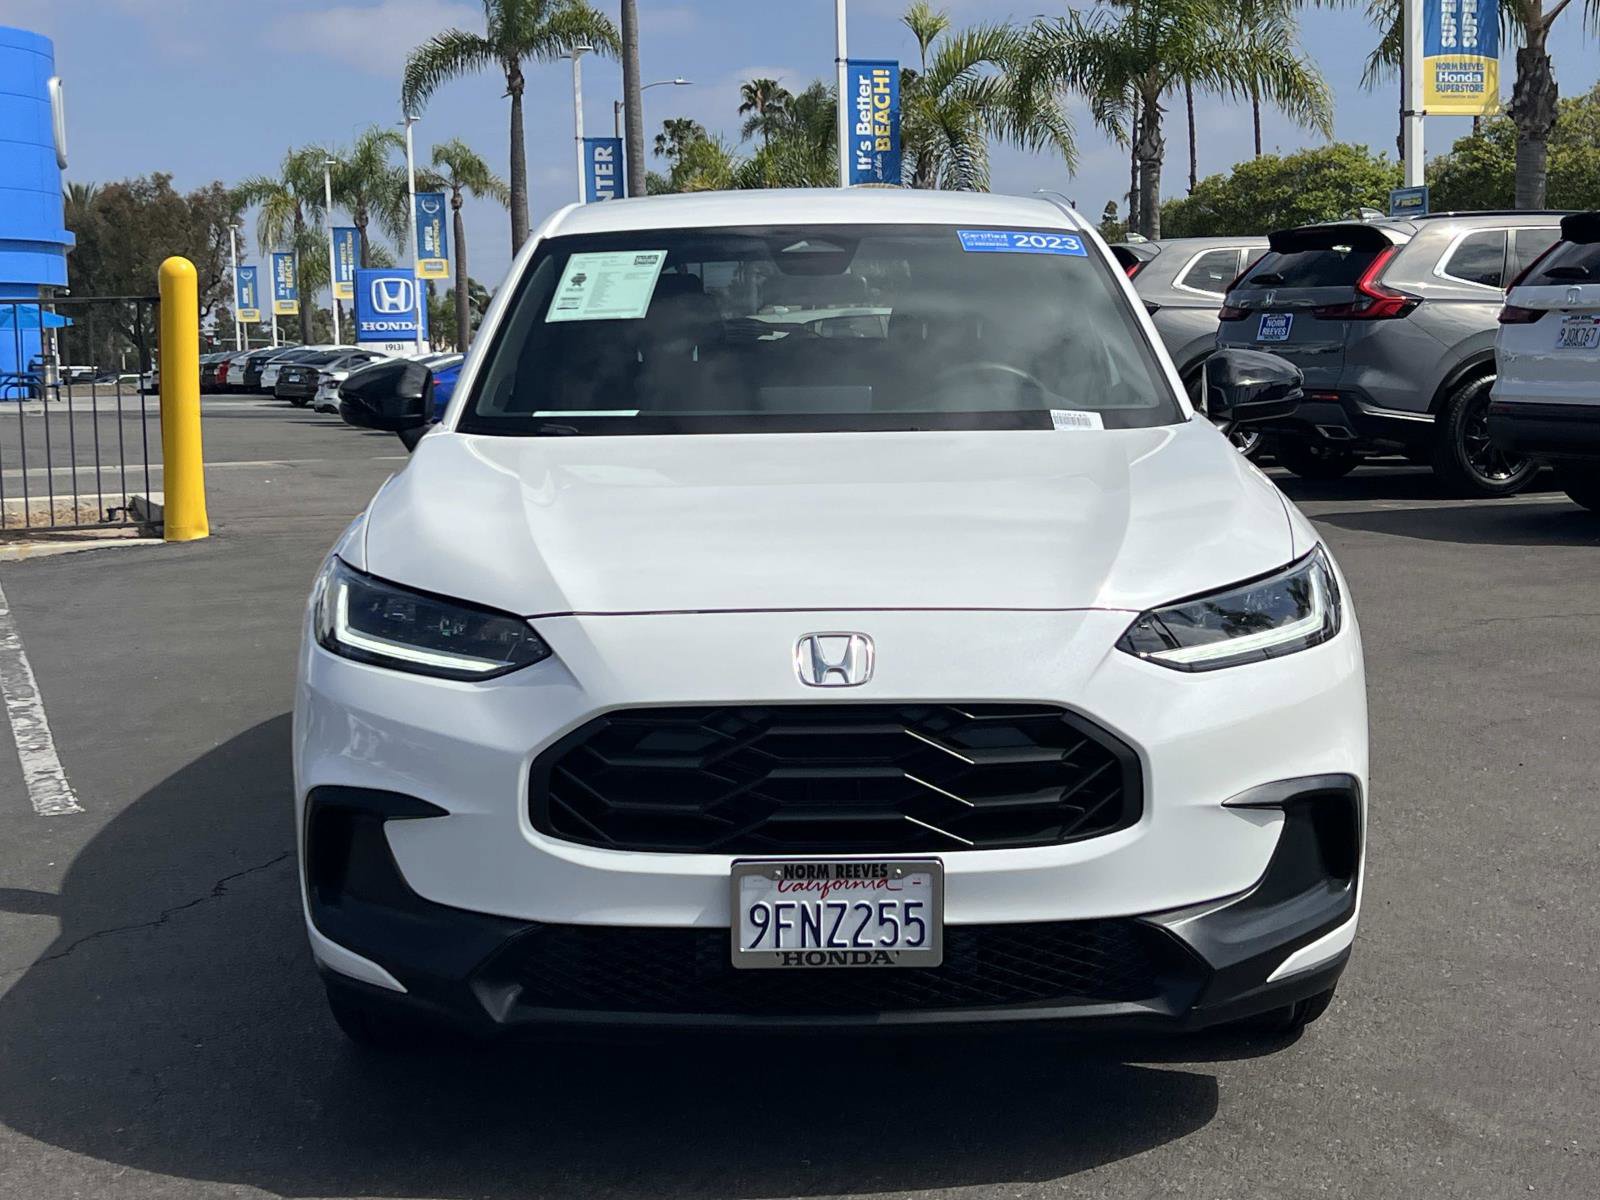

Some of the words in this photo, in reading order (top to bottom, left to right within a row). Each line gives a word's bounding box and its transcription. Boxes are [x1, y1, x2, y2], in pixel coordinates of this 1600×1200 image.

[1441, 0, 1457, 48] SUPE
[1462, 0, 1478, 48] SUPE
[1435, 62, 1458, 71] NORM
[1459, 62, 1484, 71] REEVES
[1438, 71, 1482, 82] Honda
[1435, 83, 1484, 92] SUPERSTORE
[855, 74, 872, 136] Better
[872, 69, 892, 152] BEACH!
[855, 140, 872, 171] It's
[1013, 234, 1080, 250] 2023
[783, 865, 830, 879] NORM
[835, 864, 888, 878] REEVES
[777, 878, 903, 899] California
[749, 902, 926, 949] 9FNZ255
[781, 950, 895, 966] HONDA
